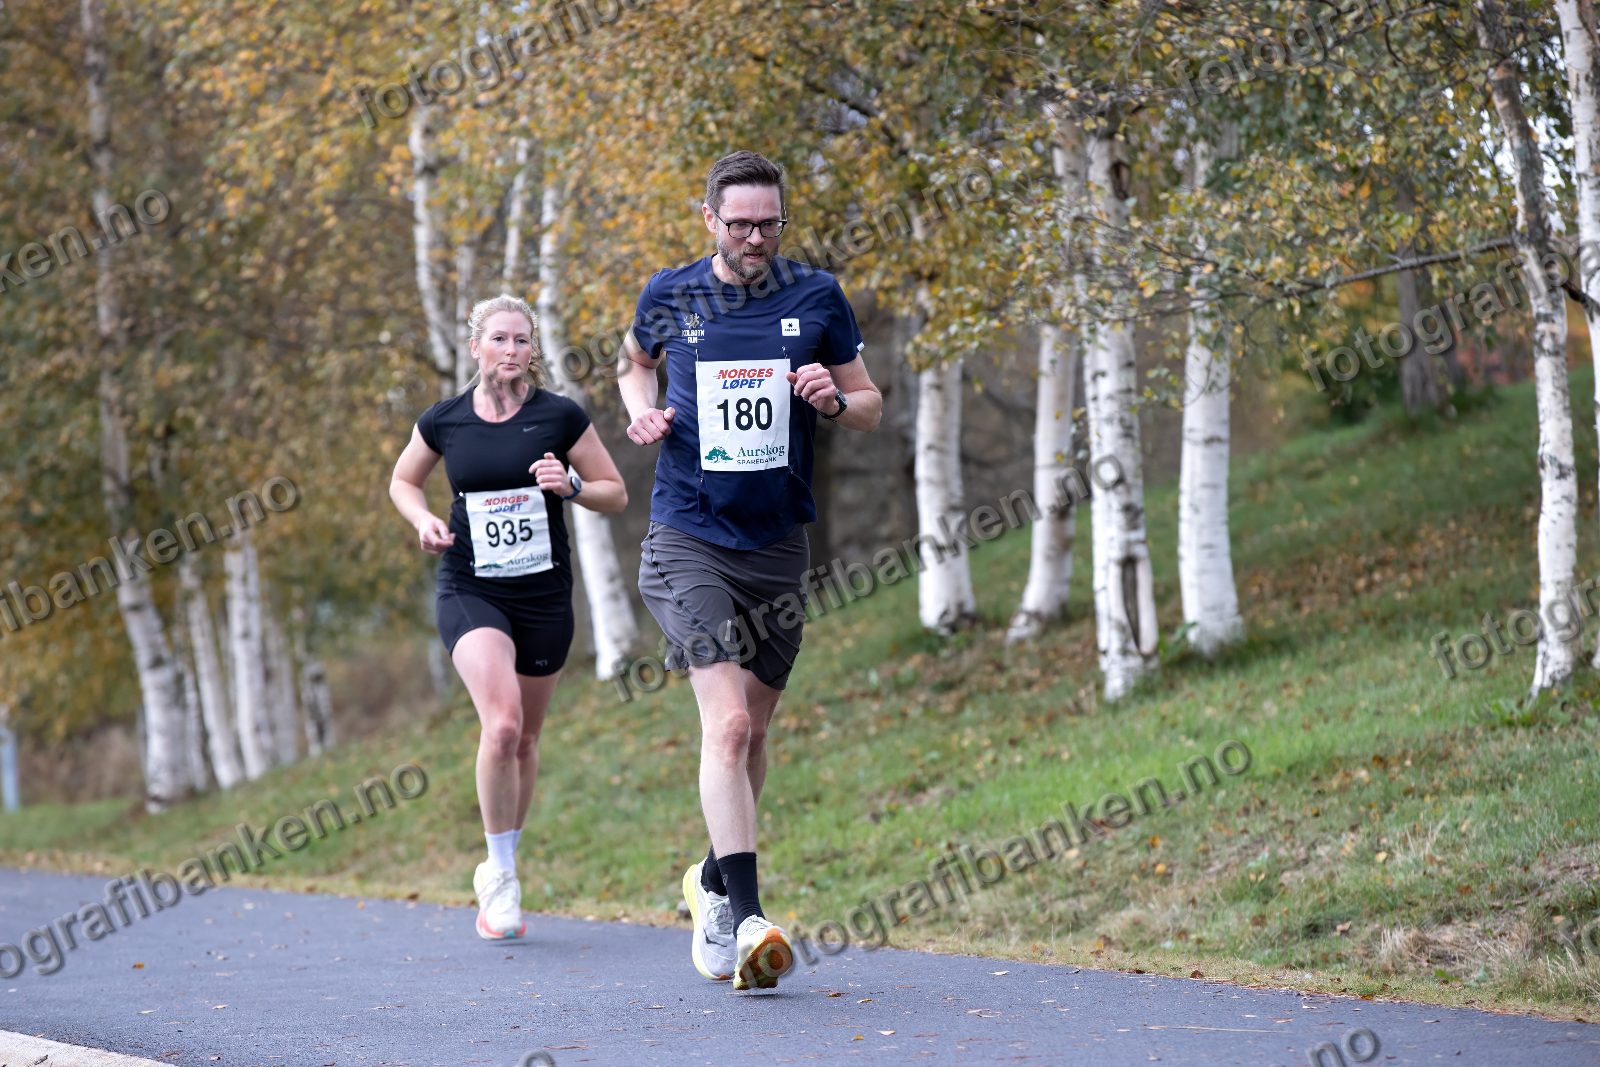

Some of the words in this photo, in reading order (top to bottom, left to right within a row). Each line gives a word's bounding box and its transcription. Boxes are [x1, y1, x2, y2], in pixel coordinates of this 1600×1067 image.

[713, 368, 774, 379] NORGES
[722, 379, 765, 389] LØPET
[716, 397, 773, 431] 180
[737, 444, 785, 457] Aurskog
[484, 495, 529, 506] NORGES
[486, 518, 533, 548] 935
